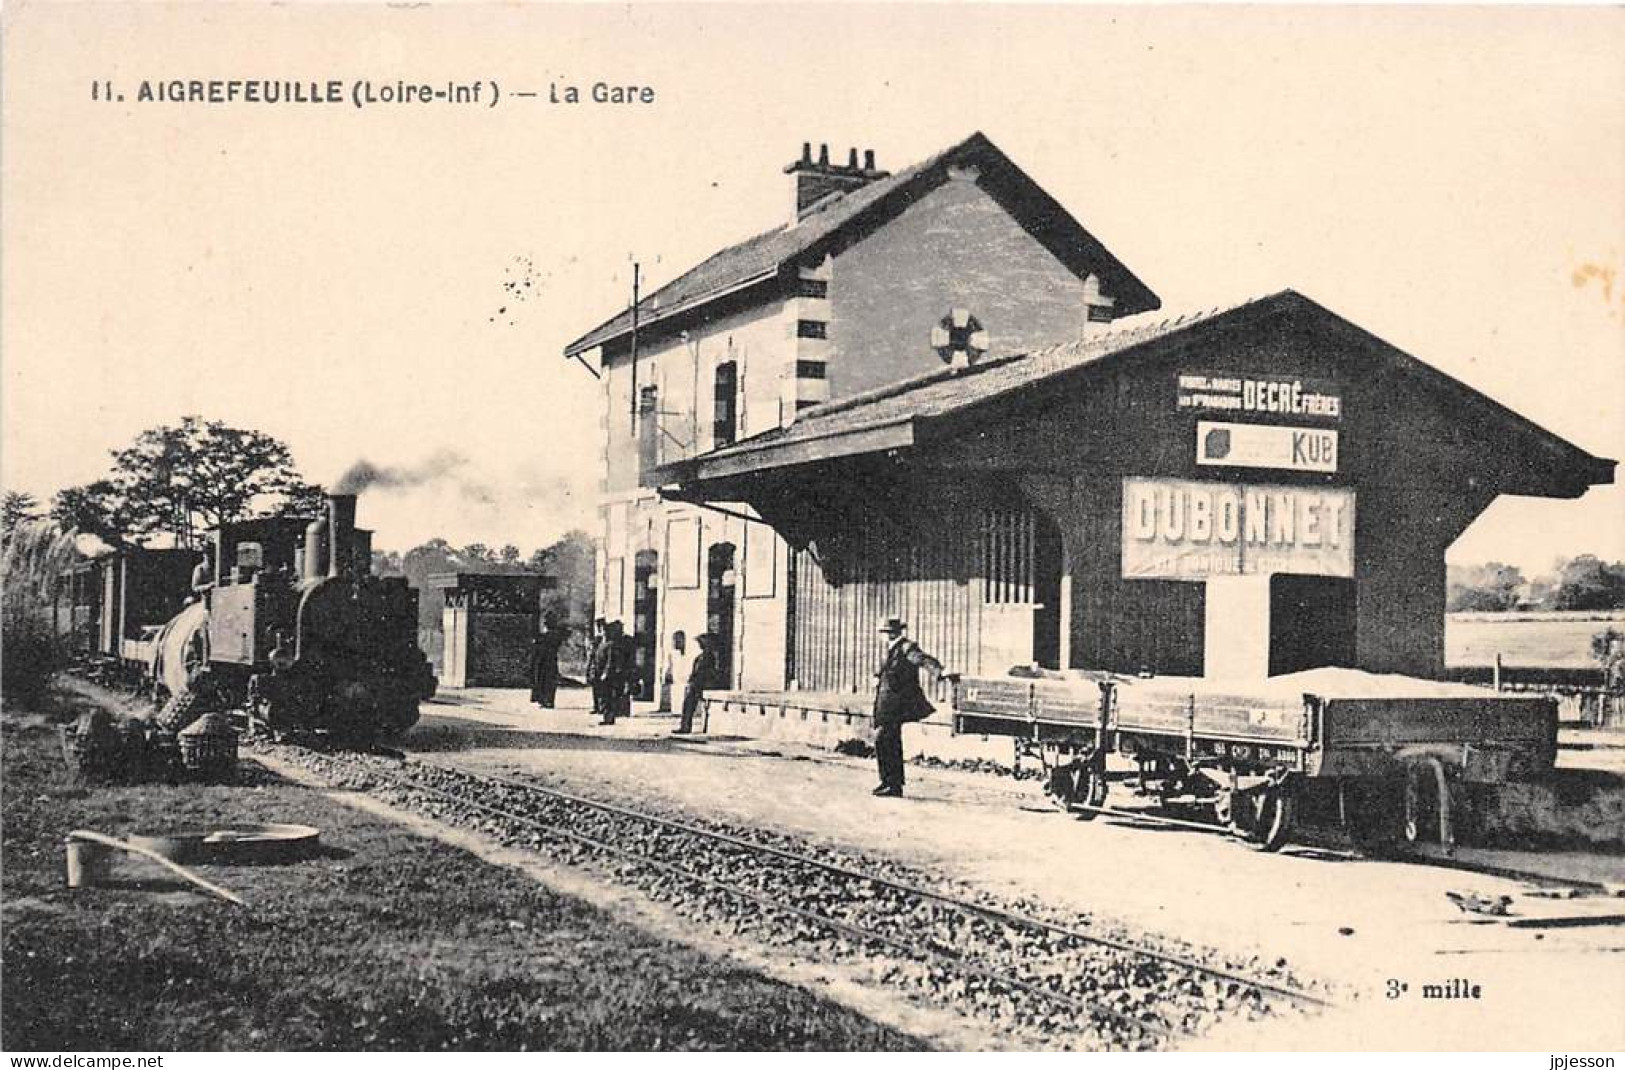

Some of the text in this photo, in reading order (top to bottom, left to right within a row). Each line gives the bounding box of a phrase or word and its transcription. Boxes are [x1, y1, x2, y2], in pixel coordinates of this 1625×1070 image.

[1243, 380, 1303, 413] DECRÉ
[1292, 431, 1333, 466] KUB
[1134, 491, 1346, 547] DUBONNET
